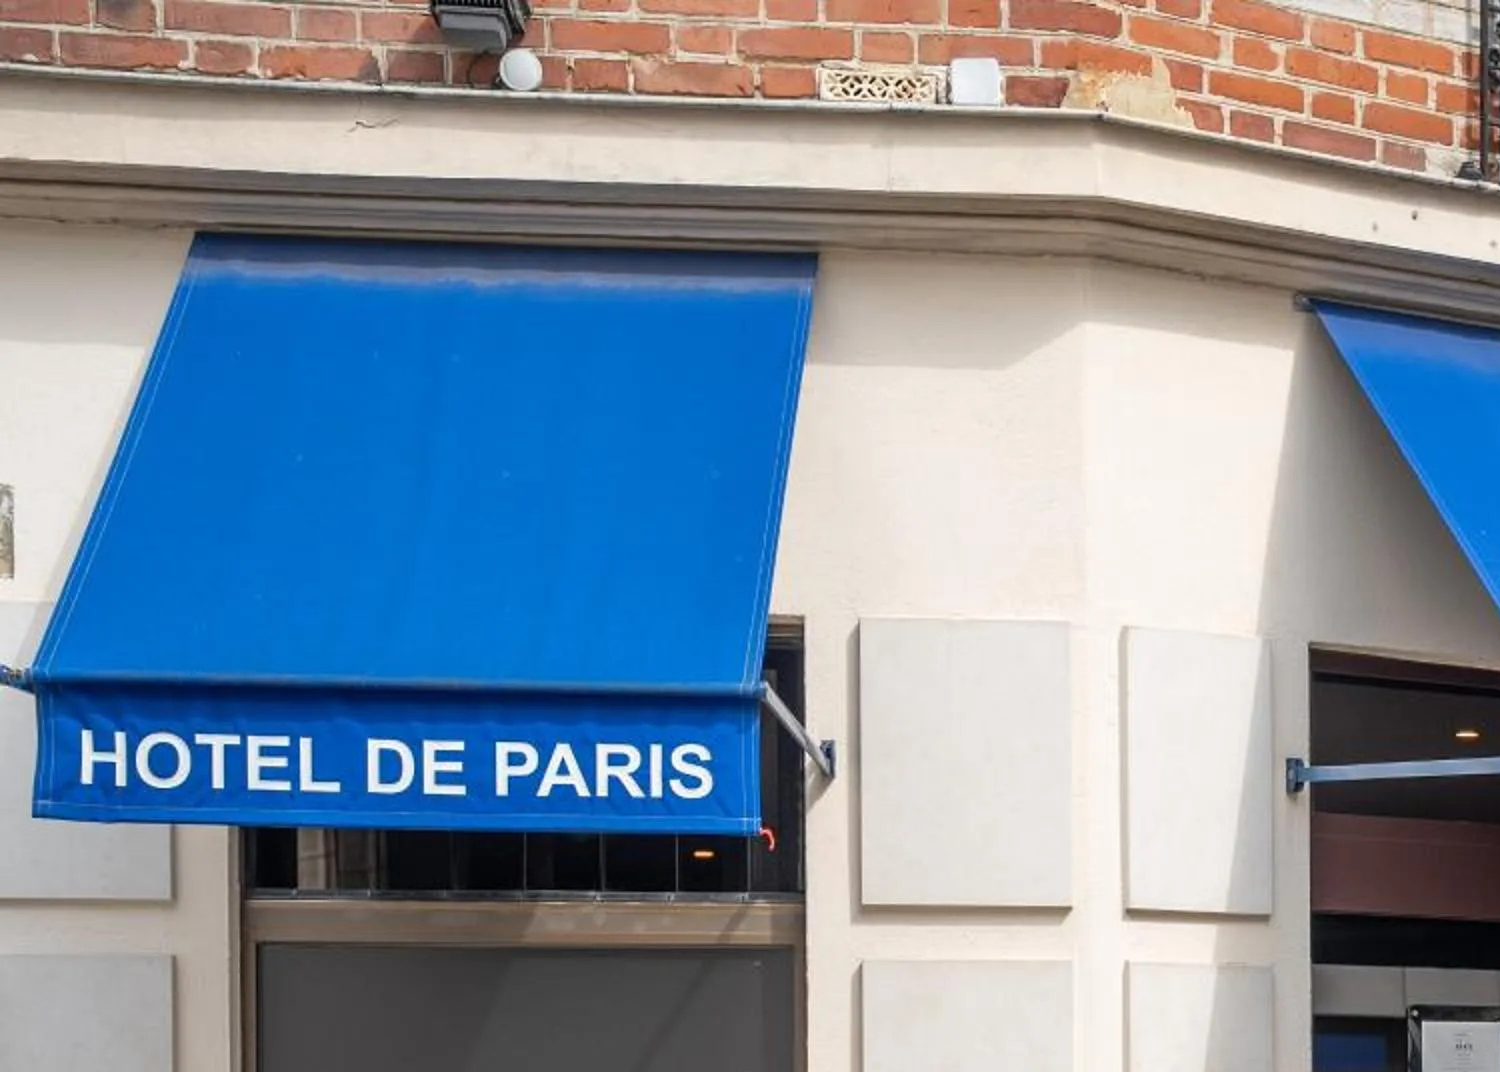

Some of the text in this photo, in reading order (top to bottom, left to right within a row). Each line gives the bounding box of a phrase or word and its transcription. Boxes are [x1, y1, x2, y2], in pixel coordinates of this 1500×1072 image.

[81, 729, 713, 799] HOTEL DE PARIS
